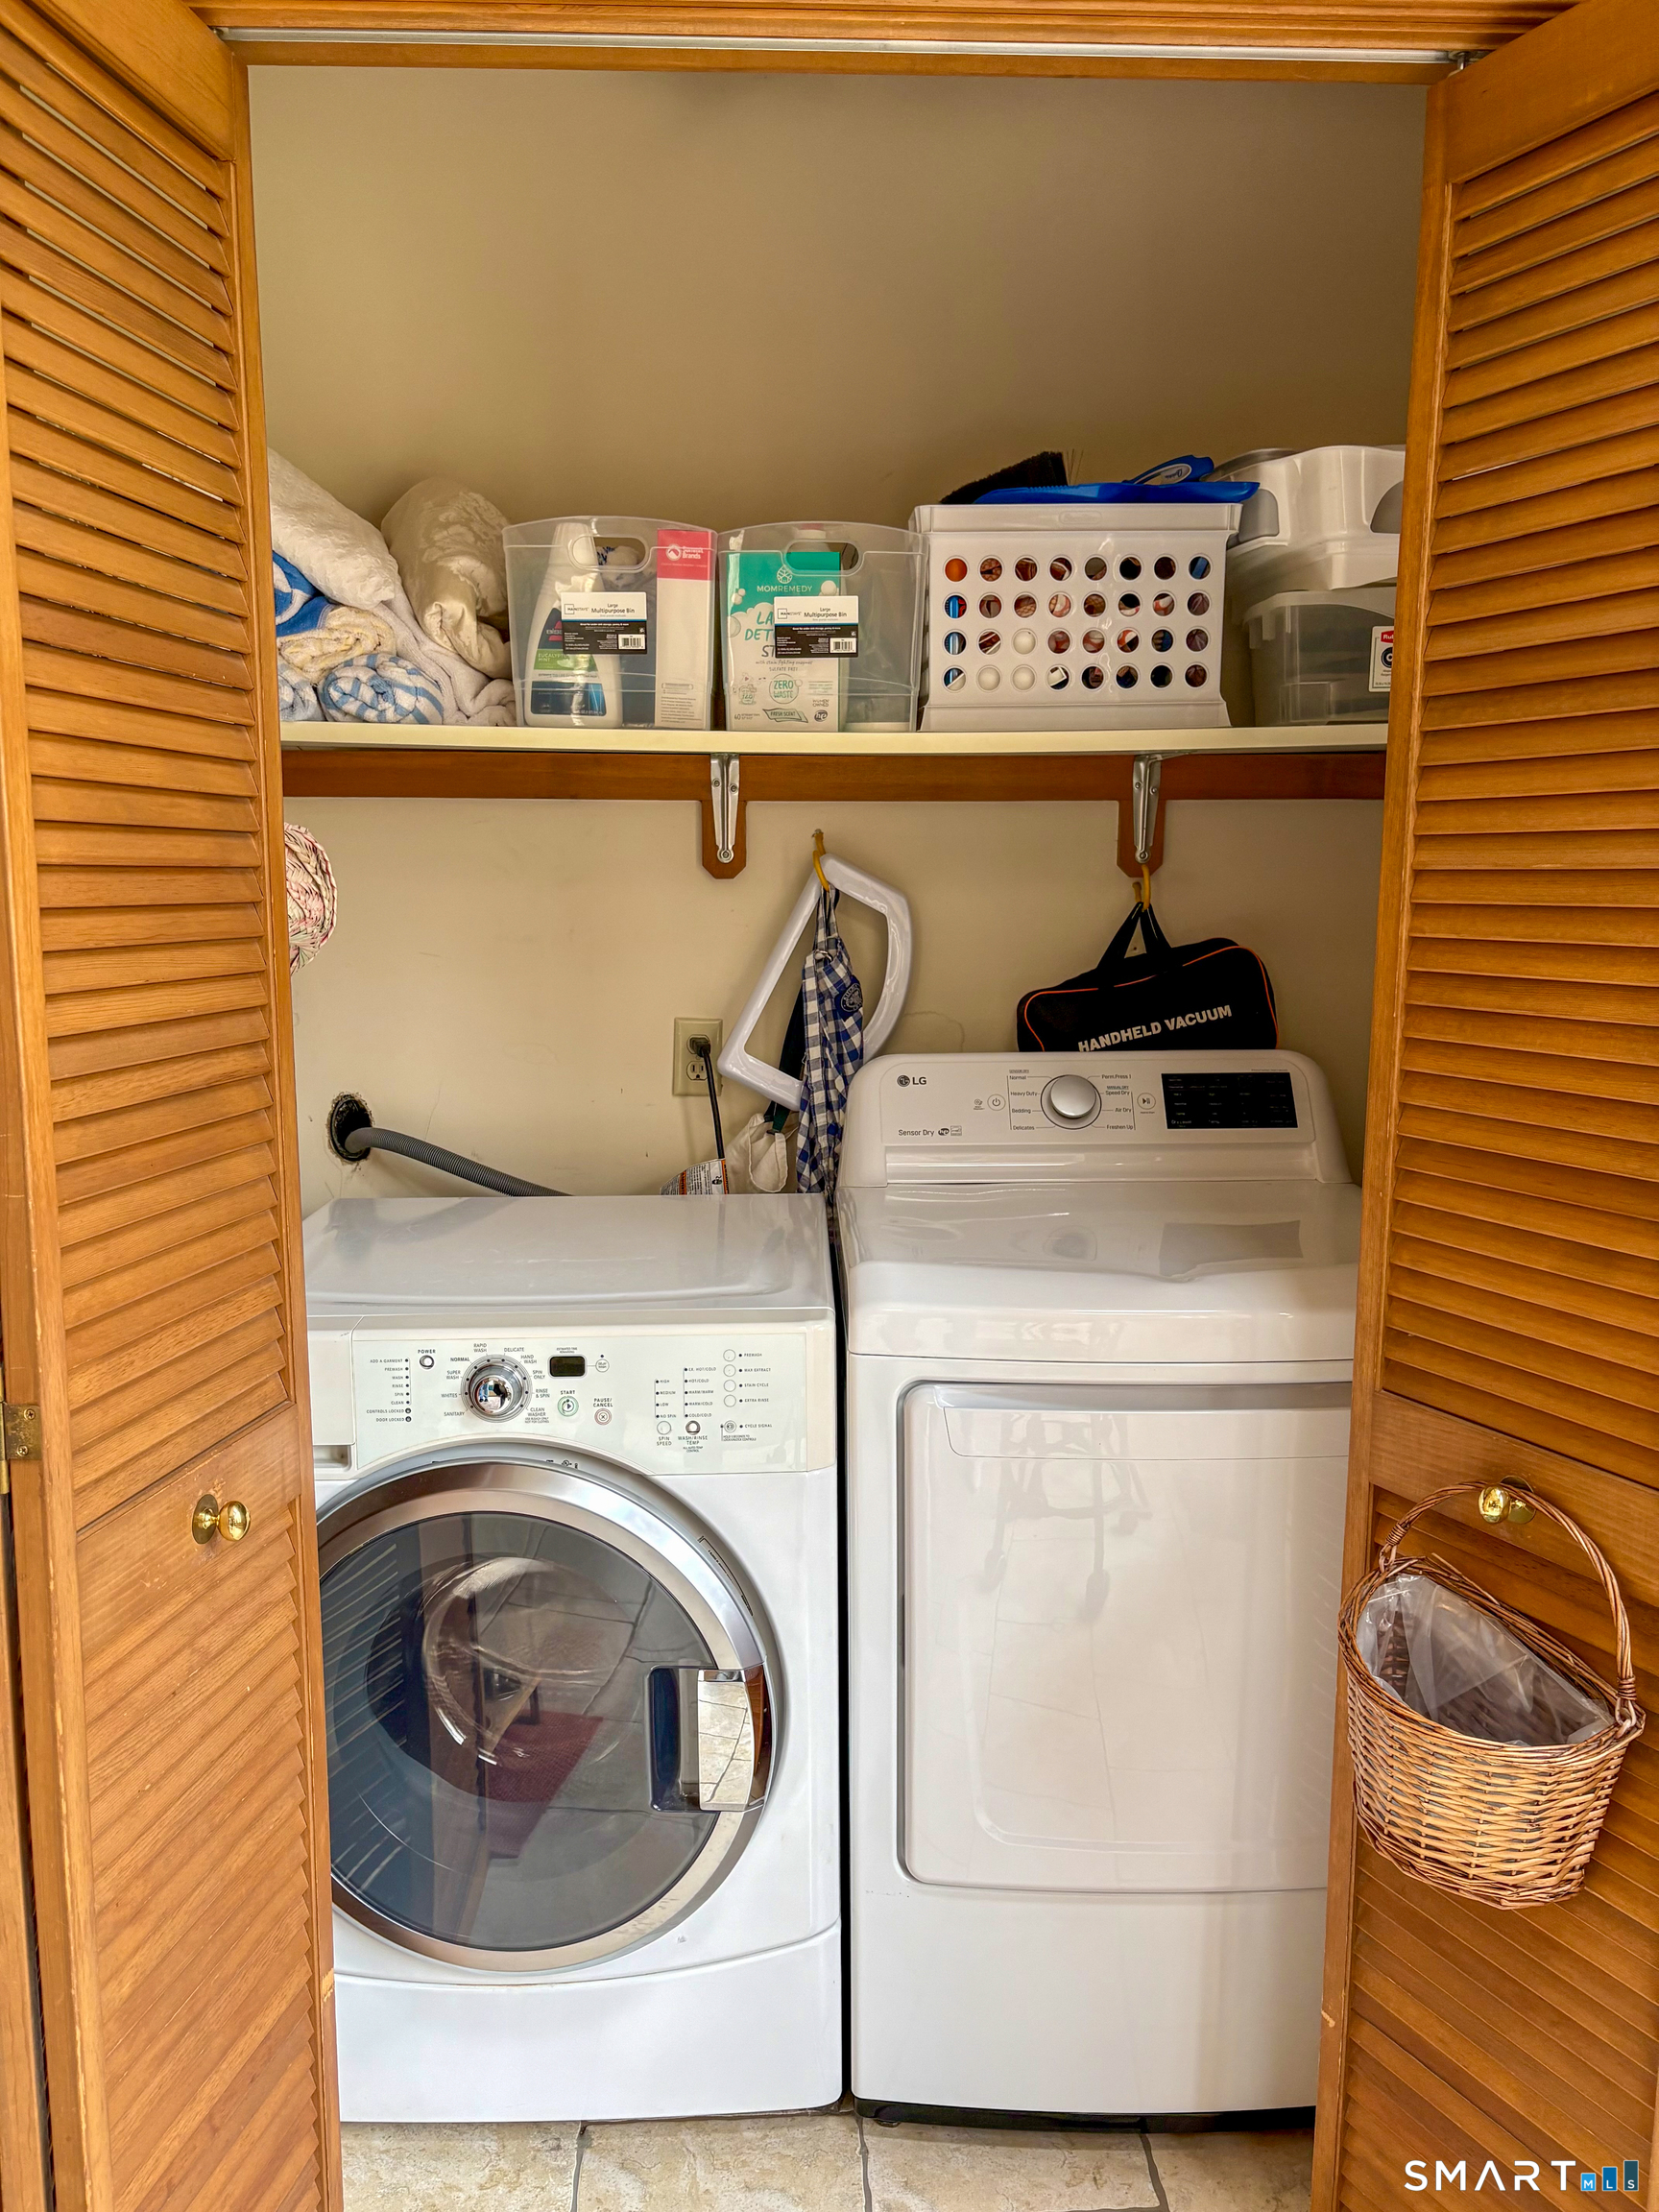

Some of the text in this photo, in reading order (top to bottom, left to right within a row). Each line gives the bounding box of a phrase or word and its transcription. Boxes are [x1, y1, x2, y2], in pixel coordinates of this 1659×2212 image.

[774, 680, 793, 690] ZERO
[1078, 1005, 1232, 1052] HANDHELD VACUUM
[912, 1077, 927, 1085] LG
